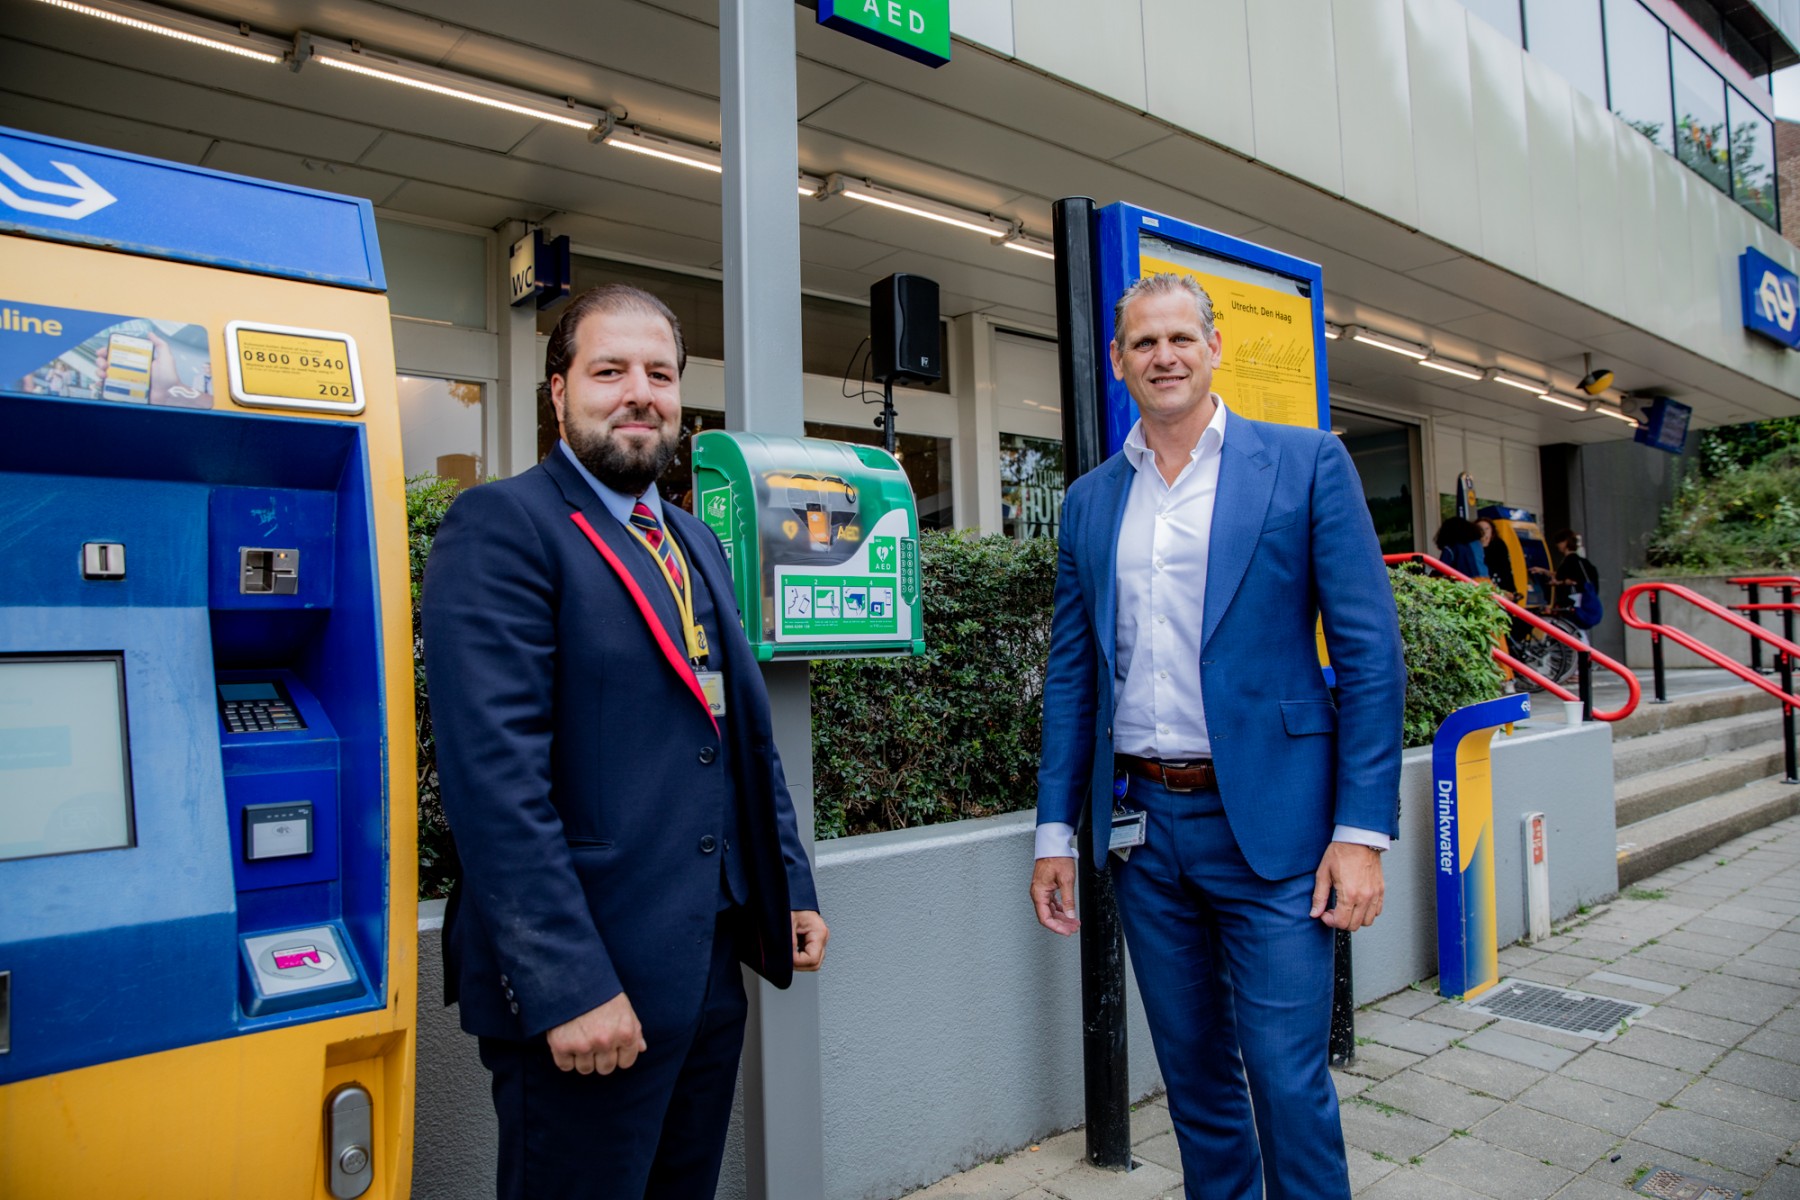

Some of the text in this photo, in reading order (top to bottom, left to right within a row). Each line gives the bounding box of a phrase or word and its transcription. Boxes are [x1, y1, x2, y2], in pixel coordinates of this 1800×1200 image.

[863, 0, 925, 34] AED
[512, 265, 533, 296] WC
[0, 308, 63, 336] line
[1231, 300, 1292, 324] Utrecht, Den Haag
[243, 350, 290, 365] 0800
[300, 356, 344, 370] 0540
[319, 384, 350, 397] 202
[1437, 780, 1454, 876] Drinkwater
